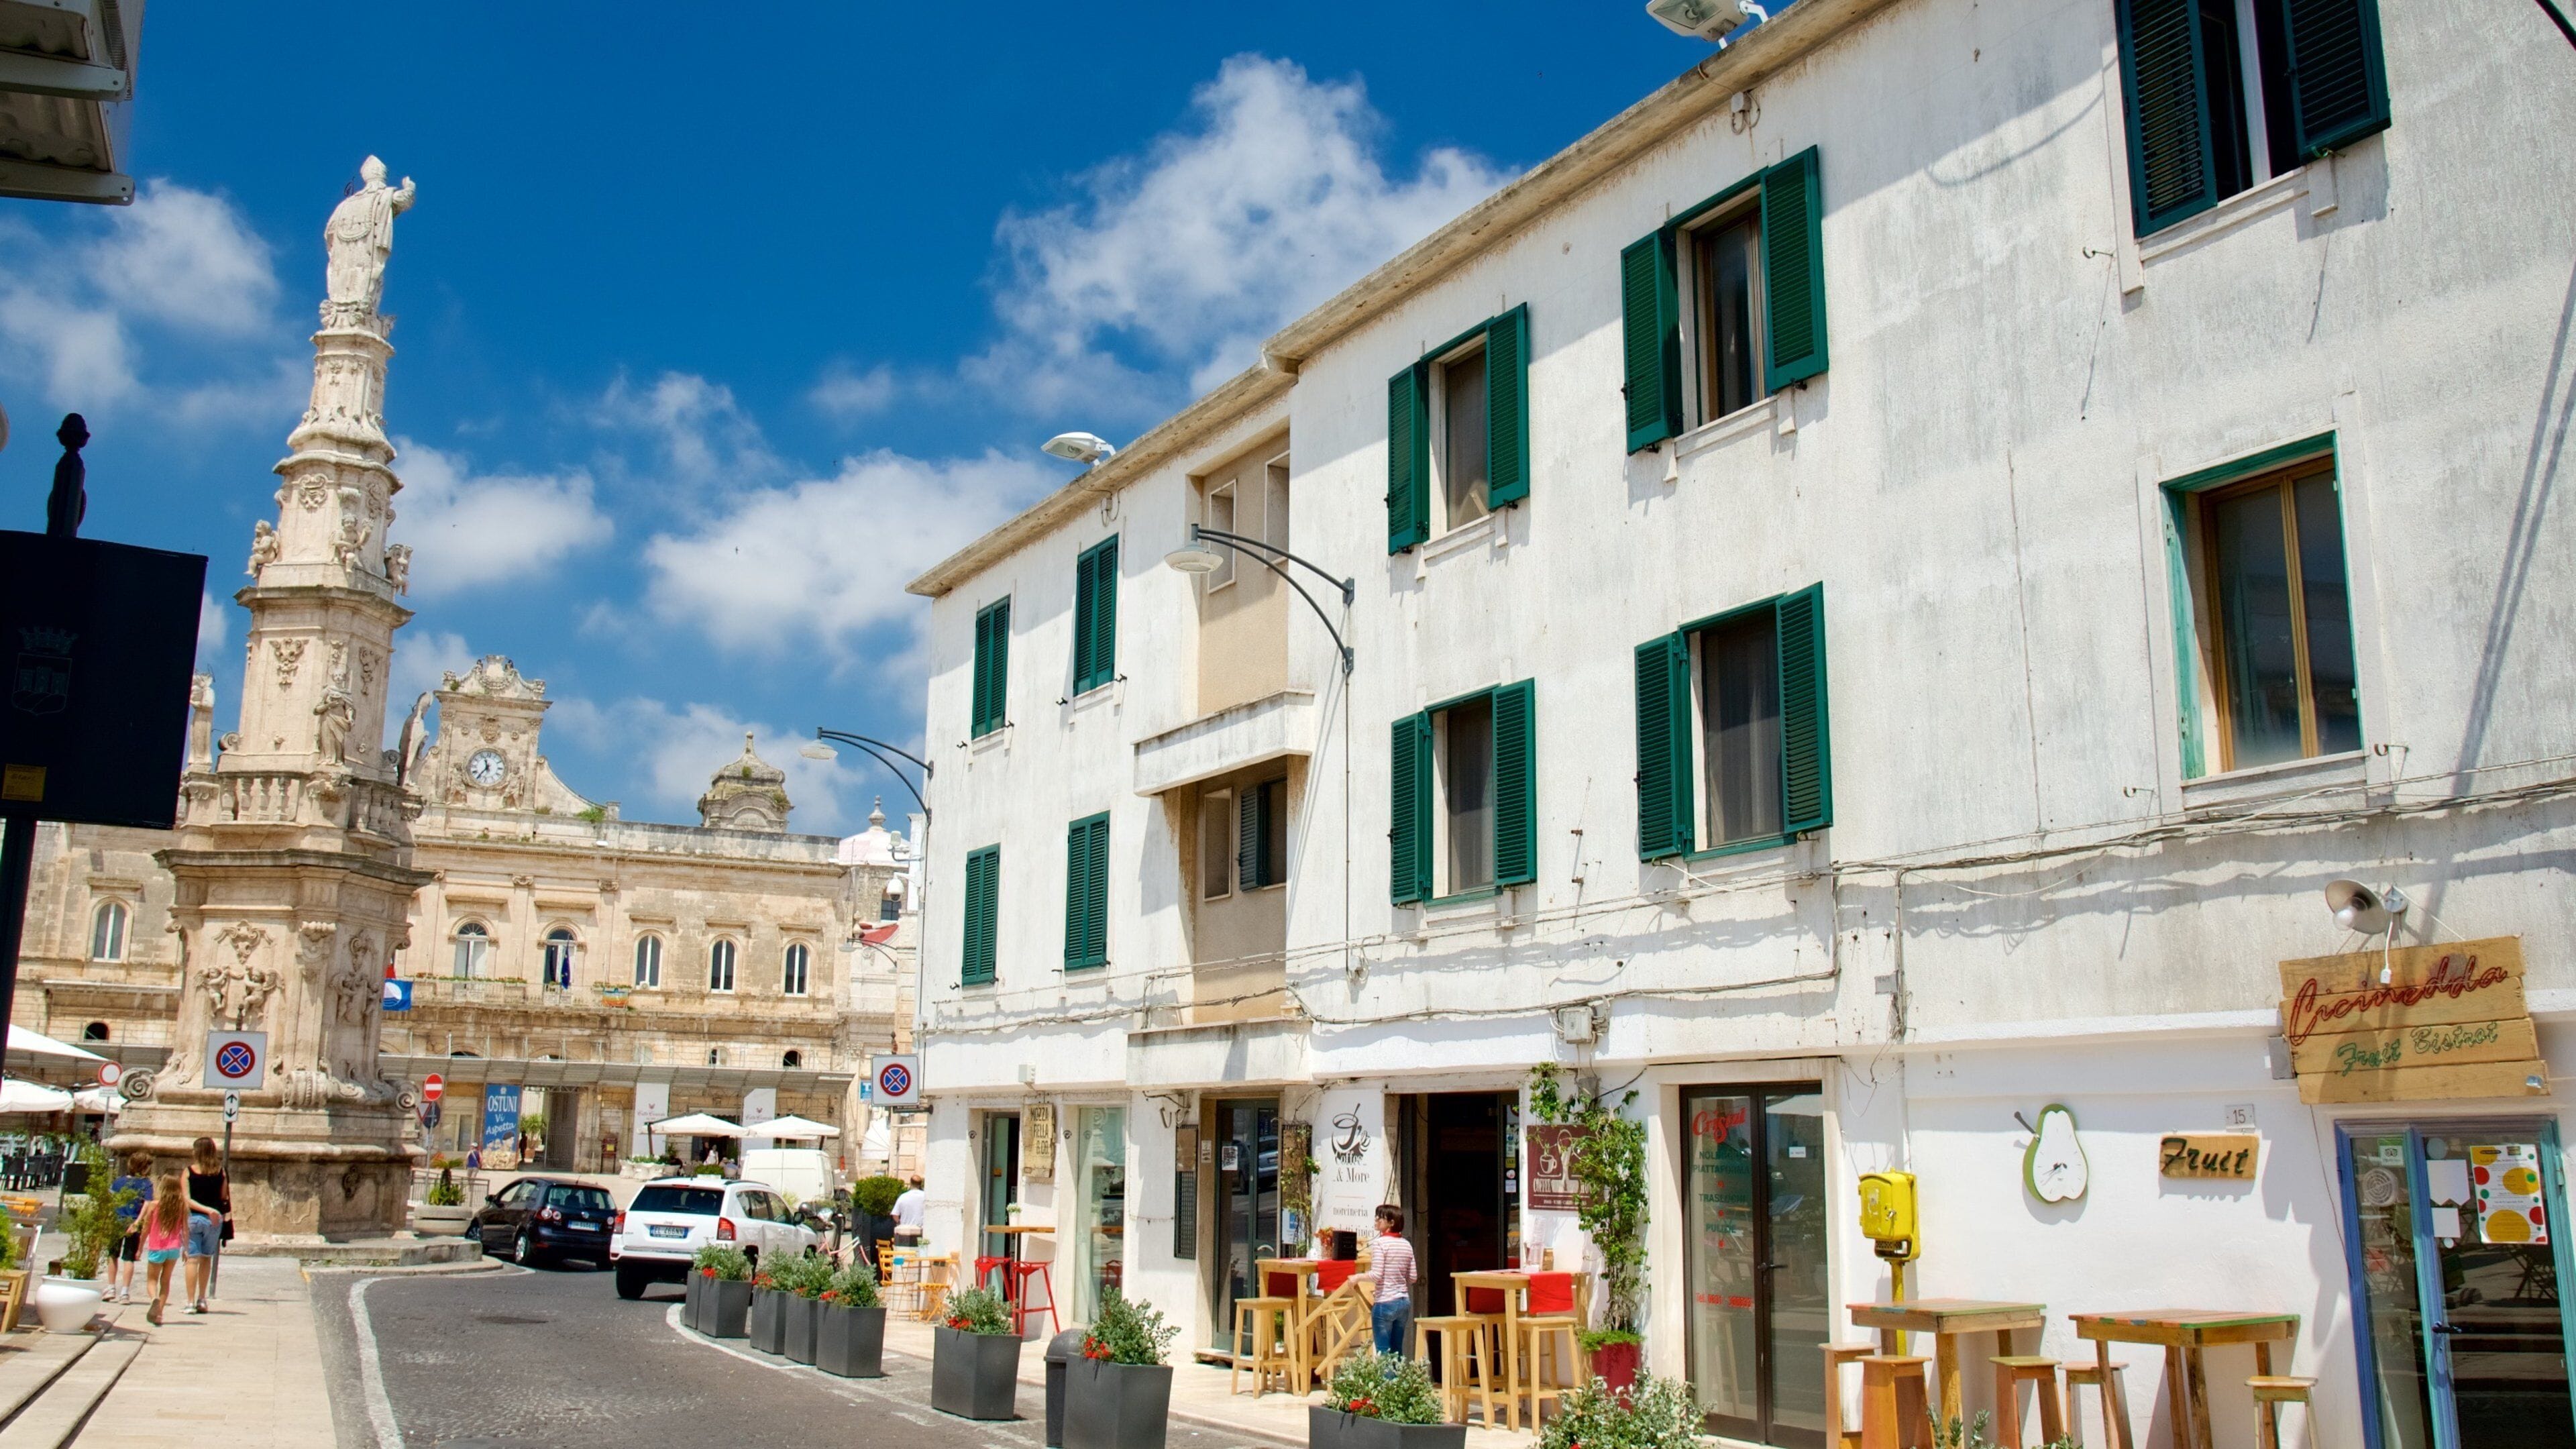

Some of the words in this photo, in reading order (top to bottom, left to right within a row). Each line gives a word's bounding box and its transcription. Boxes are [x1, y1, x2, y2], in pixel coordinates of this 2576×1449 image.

[2337, 1039, 2402, 1076] Fruit
[2410, 1021, 2499, 1054] Bistrot
[488, 1095, 517, 1113] OSTUNI
[495, 1114, 505, 1124] Vi
[1030, 1107, 1049, 1122] MOZZA
[2233, 1109, 2246, 1124] 15
[486, 1122, 516, 1136] Aspetta
[1034, 1124, 1049, 1138] RELLA
[2160, 1137, 2249, 1174] Fruit
[1346, 1168, 1370, 1183] More
[1534, 1178, 1551, 1193] COFFEE
[1333, 1204, 1368, 1218] norcineria
